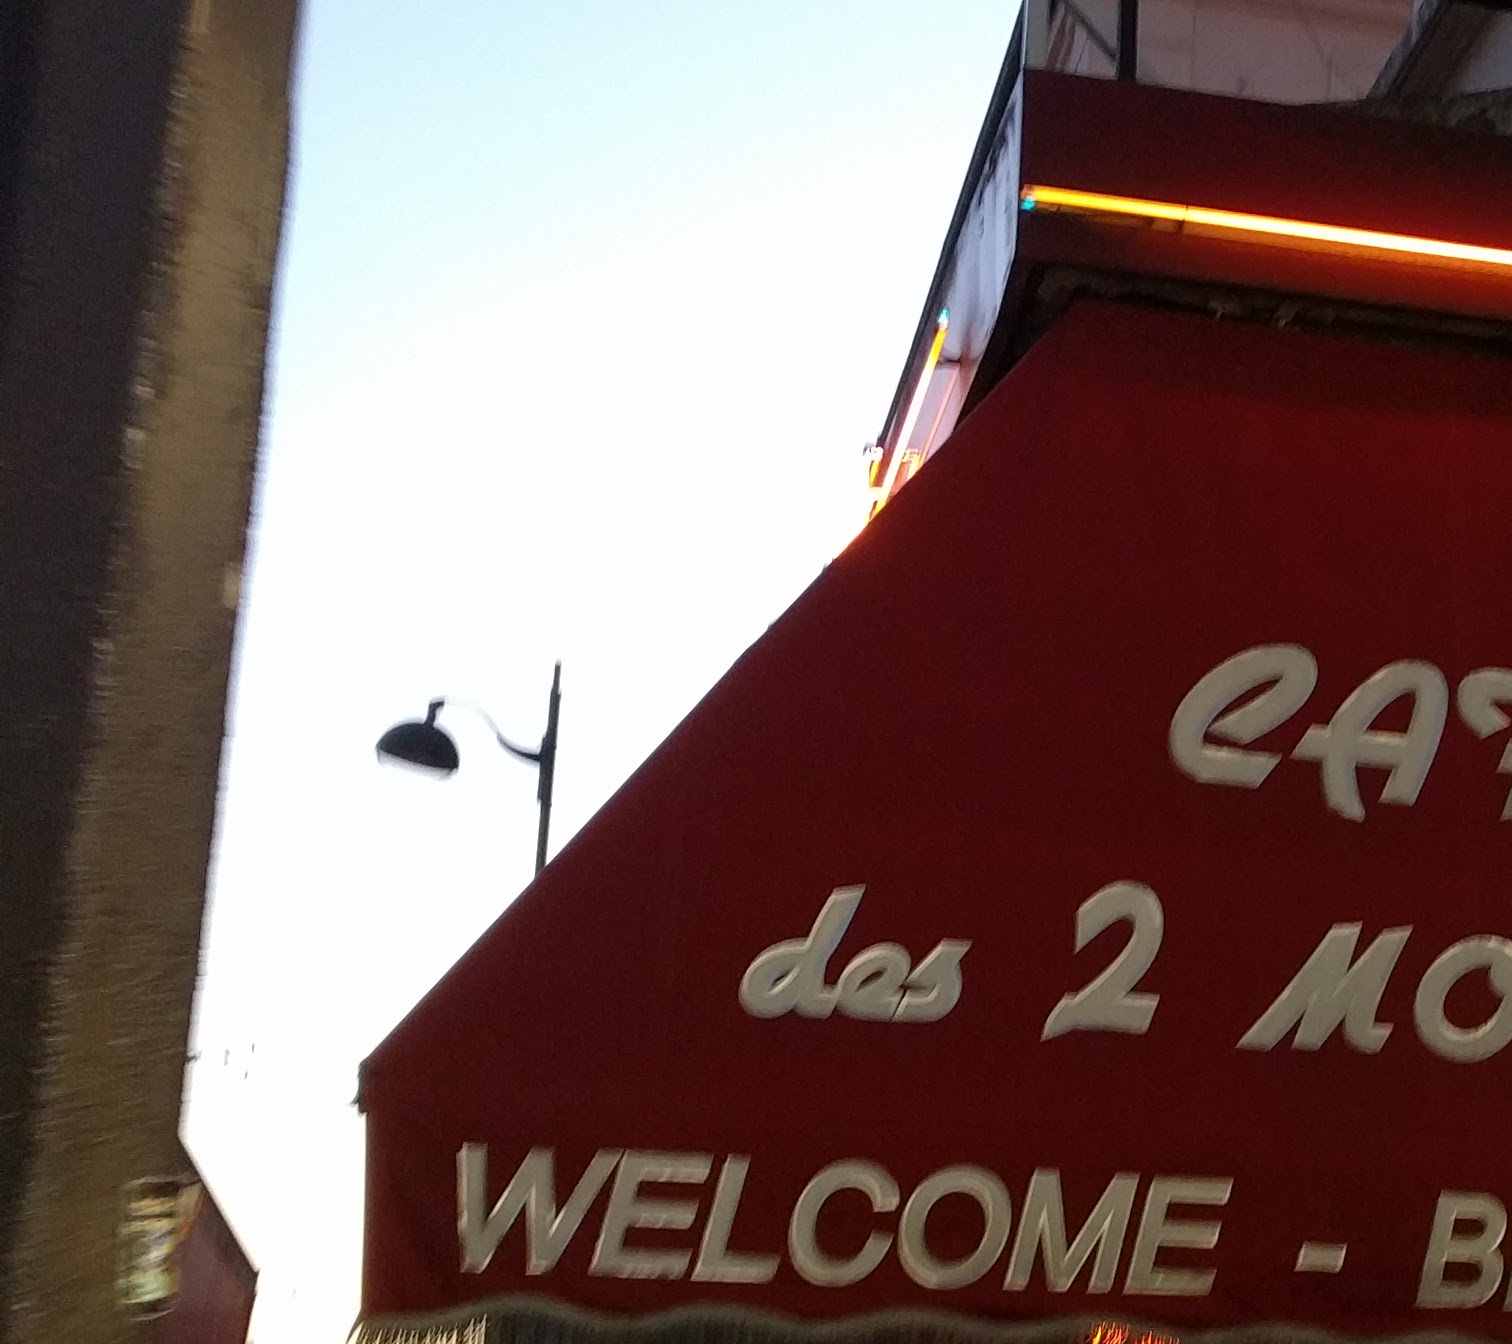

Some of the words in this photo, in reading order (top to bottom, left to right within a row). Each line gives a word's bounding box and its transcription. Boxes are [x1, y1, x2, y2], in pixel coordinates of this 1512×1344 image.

[737, 884, 972, 1023] des
[1040, 879, 1164, 1042] 2
[454, 1141, 1235, 1296] WELCOME
